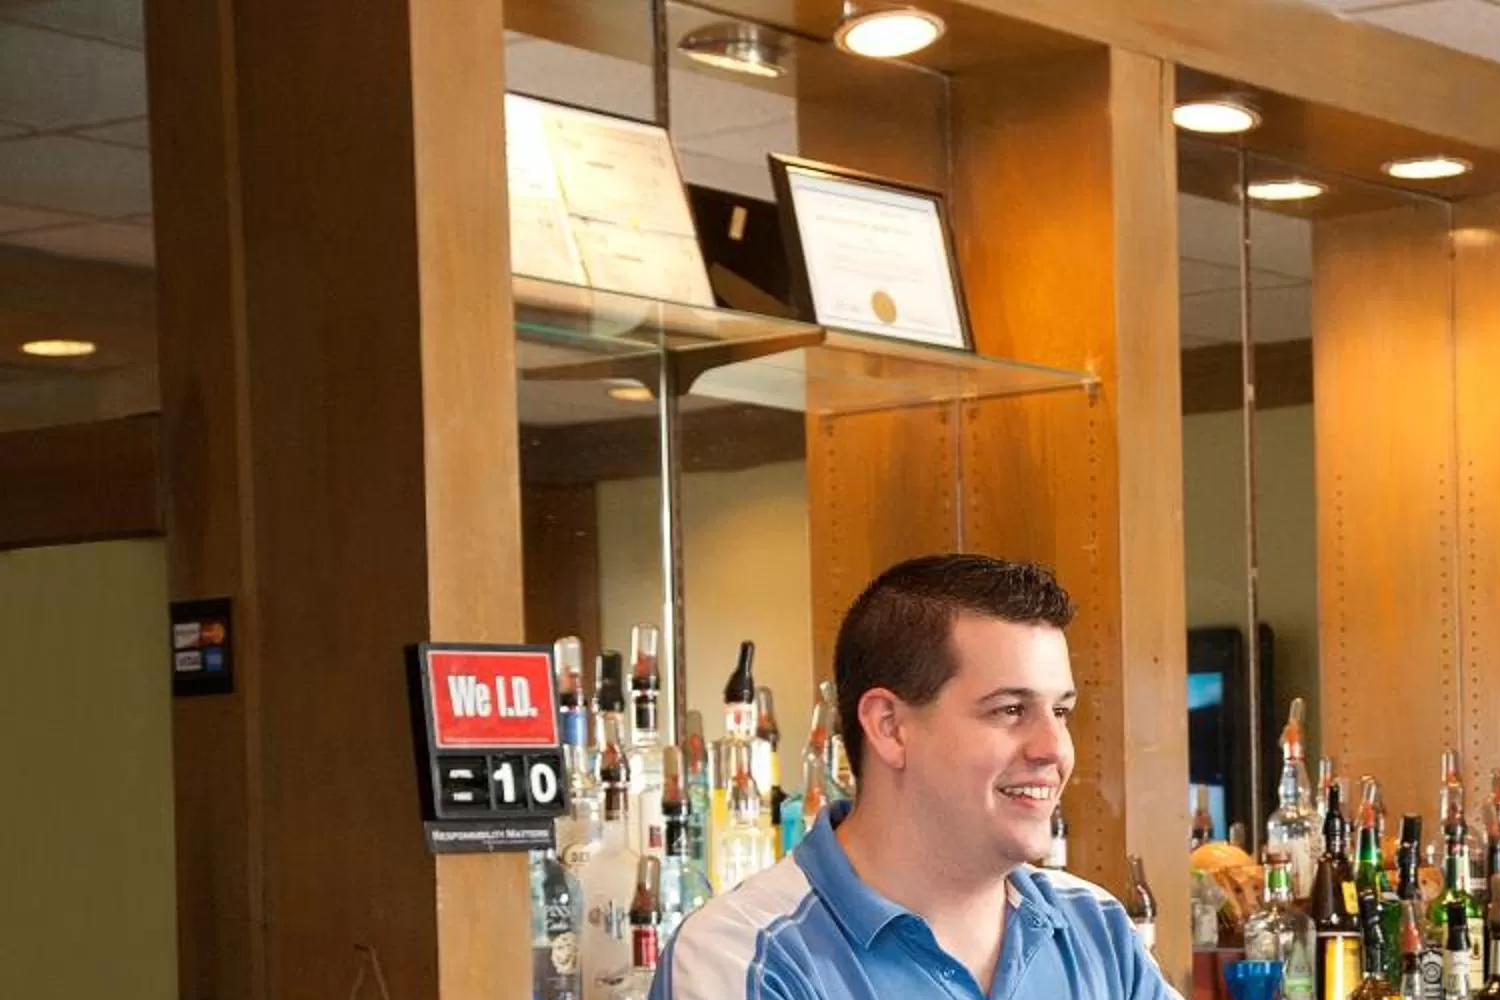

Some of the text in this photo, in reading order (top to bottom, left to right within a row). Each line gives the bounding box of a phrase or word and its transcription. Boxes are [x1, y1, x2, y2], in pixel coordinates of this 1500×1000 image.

[448, 675, 539, 718] We I.D.
[493, 762, 558, 804] 10
